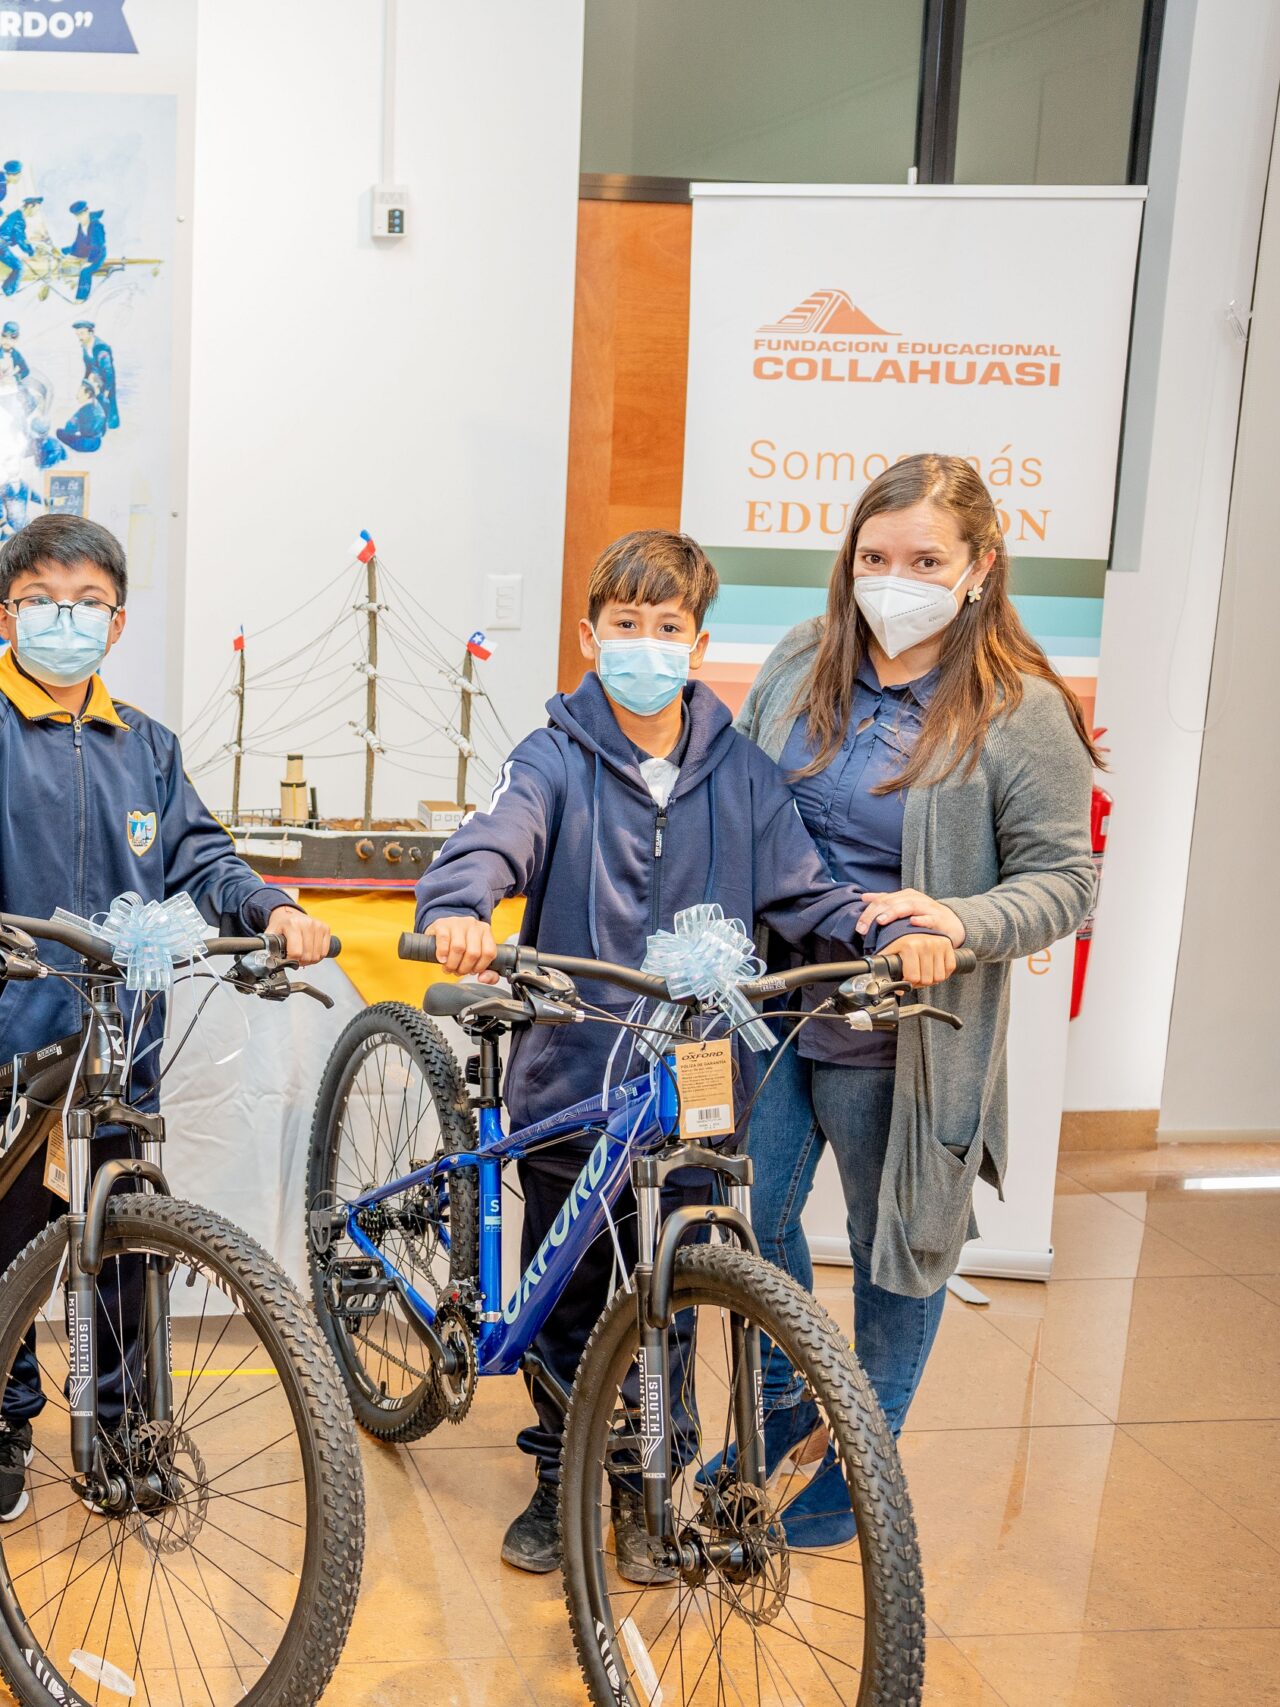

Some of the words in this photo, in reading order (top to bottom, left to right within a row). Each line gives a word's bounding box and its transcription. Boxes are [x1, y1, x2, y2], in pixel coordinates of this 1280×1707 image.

[753, 338, 888, 354] FUNDACION
[896, 342, 1062, 357] EDUCACIONAL
[752, 356, 1062, 387] COLLAHUASI
[747, 438, 904, 482] Somo
[682, 1051, 724, 1060] OXFORD
[490, 1199, 500, 1212] S
[504, 1134, 608, 1325] OXFORD
[78, 1323, 90, 1372] SOUTH
[648, 1382, 660, 1432] SOUTH
